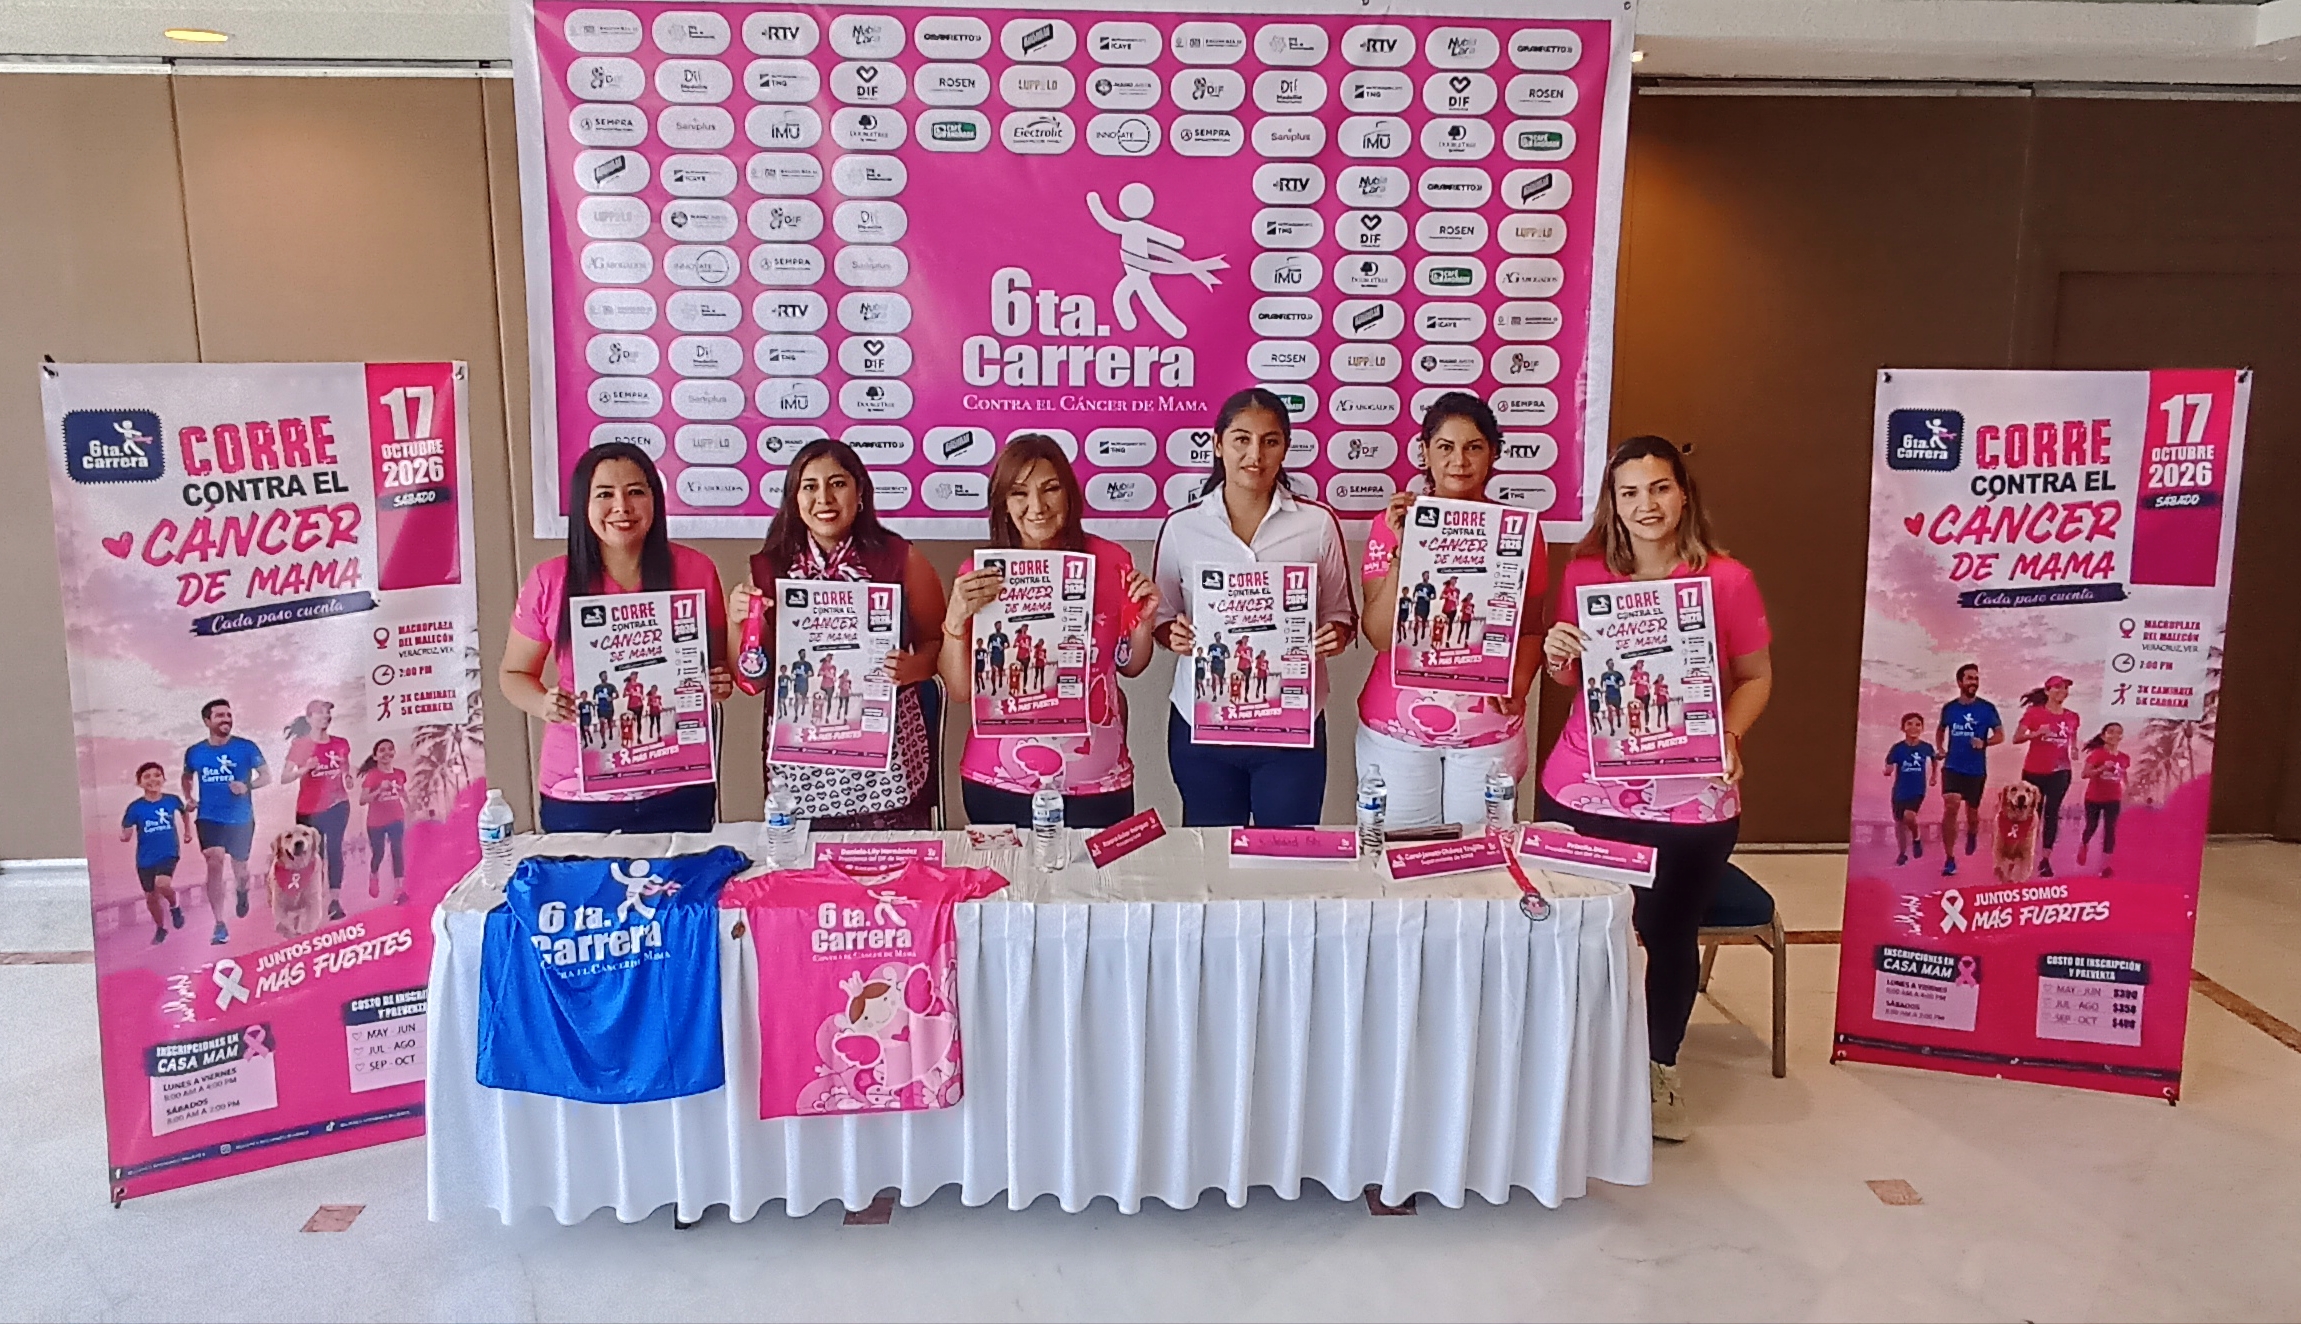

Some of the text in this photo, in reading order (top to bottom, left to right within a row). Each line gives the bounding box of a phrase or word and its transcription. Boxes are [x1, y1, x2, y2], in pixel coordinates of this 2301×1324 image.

[857, 86, 879, 97] DIF
[939, 77, 976, 88] ROSEN
[1448, 96, 1470, 107] DIF
[1529, 88, 1564, 99] ROSEN
[595, 118, 634, 127] SEMPRA
[1194, 128, 1231, 137] SEMPRA
[1360, 233, 1381, 244] DIF
[1439, 225, 1475, 236] ROSEN
[774, 258, 811, 266] SEMPRA
[991, 266, 1110, 337] 6ta.
[864, 358, 885, 369] DIF
[962, 335, 1195, 387] Carrera
[1271, 354, 1306, 364] ROSEN
[380, 385, 435, 442] 17
[1510, 400, 1546, 408] SEMPRA
[2159, 392, 2213, 446] 17
[89, 440, 124, 459] 6ta.
[178, 414, 338, 477] CORRE
[381, 438, 444, 459] OCTUBRE
[1902, 434, 1928, 449] 6ta.
[1975, 419, 2112, 470] CORRE
[82, 453, 149, 471] Carrera
[1190, 450, 1213, 460] DIF
[1896, 447, 1948, 460] Carrera
[2152, 444, 2214, 462] OCTUBRE
[382, 456, 444, 488] 2026
[2148, 461, 2213, 489] 2026
[182, 470, 349, 506] CONTRA EL
[1350, 485, 1384, 494] SEMPRA
[1970, 470, 2116, 496] CONTRA EL
[1444, 510, 1486, 527] CORRE
[1504, 515, 1524, 534] 17
[1927, 495, 2122, 545] CÁNCER
[142, 502, 362, 568] CÁNCER
[1010, 559, 1050, 576] CORRE
[1452, 554, 1486, 565] MAMA
[1949, 550, 2116, 582] DE MAMA
[1066, 560, 1085, 580] 17
[176, 556, 362, 608] DE MAMA
[1286, 571, 1305, 590] 17
[813, 590, 854, 606] CORRE
[871, 591, 889, 610] 17
[1021, 602, 1053, 612] MAMA
[1616, 590, 1661, 611] CORRE
[1678, 587, 1699, 608] 17
[210, 598, 346, 633] Cada paso cuenta
[611, 601, 656, 622] CORRE
[673, 599, 694, 618] 17
[1974, 884, 2068, 908] JUNTOS SOMOS
[538, 901, 612, 934] 6 ta.
[818, 902, 871, 929] 6 ta.
[1971, 900, 2110, 932] MÁS FUERTES
[255, 922, 366, 972] JUNTOS SOMOS
[811, 928, 912, 954] Carrera
[255, 928, 413, 999] MÁS FUERTES
[1884, 958, 1953, 978] CASA MAM
[2046, 955, 2074, 966] COSTO
[367, 1022, 416, 1040] MAY JUN
[368, 1039, 416, 1056] JUL AGO
[158, 1044, 239, 1074] CASA MAM
[370, 1054, 416, 1072] SEP OCT
[163, 1079, 192, 1092] LUNES
